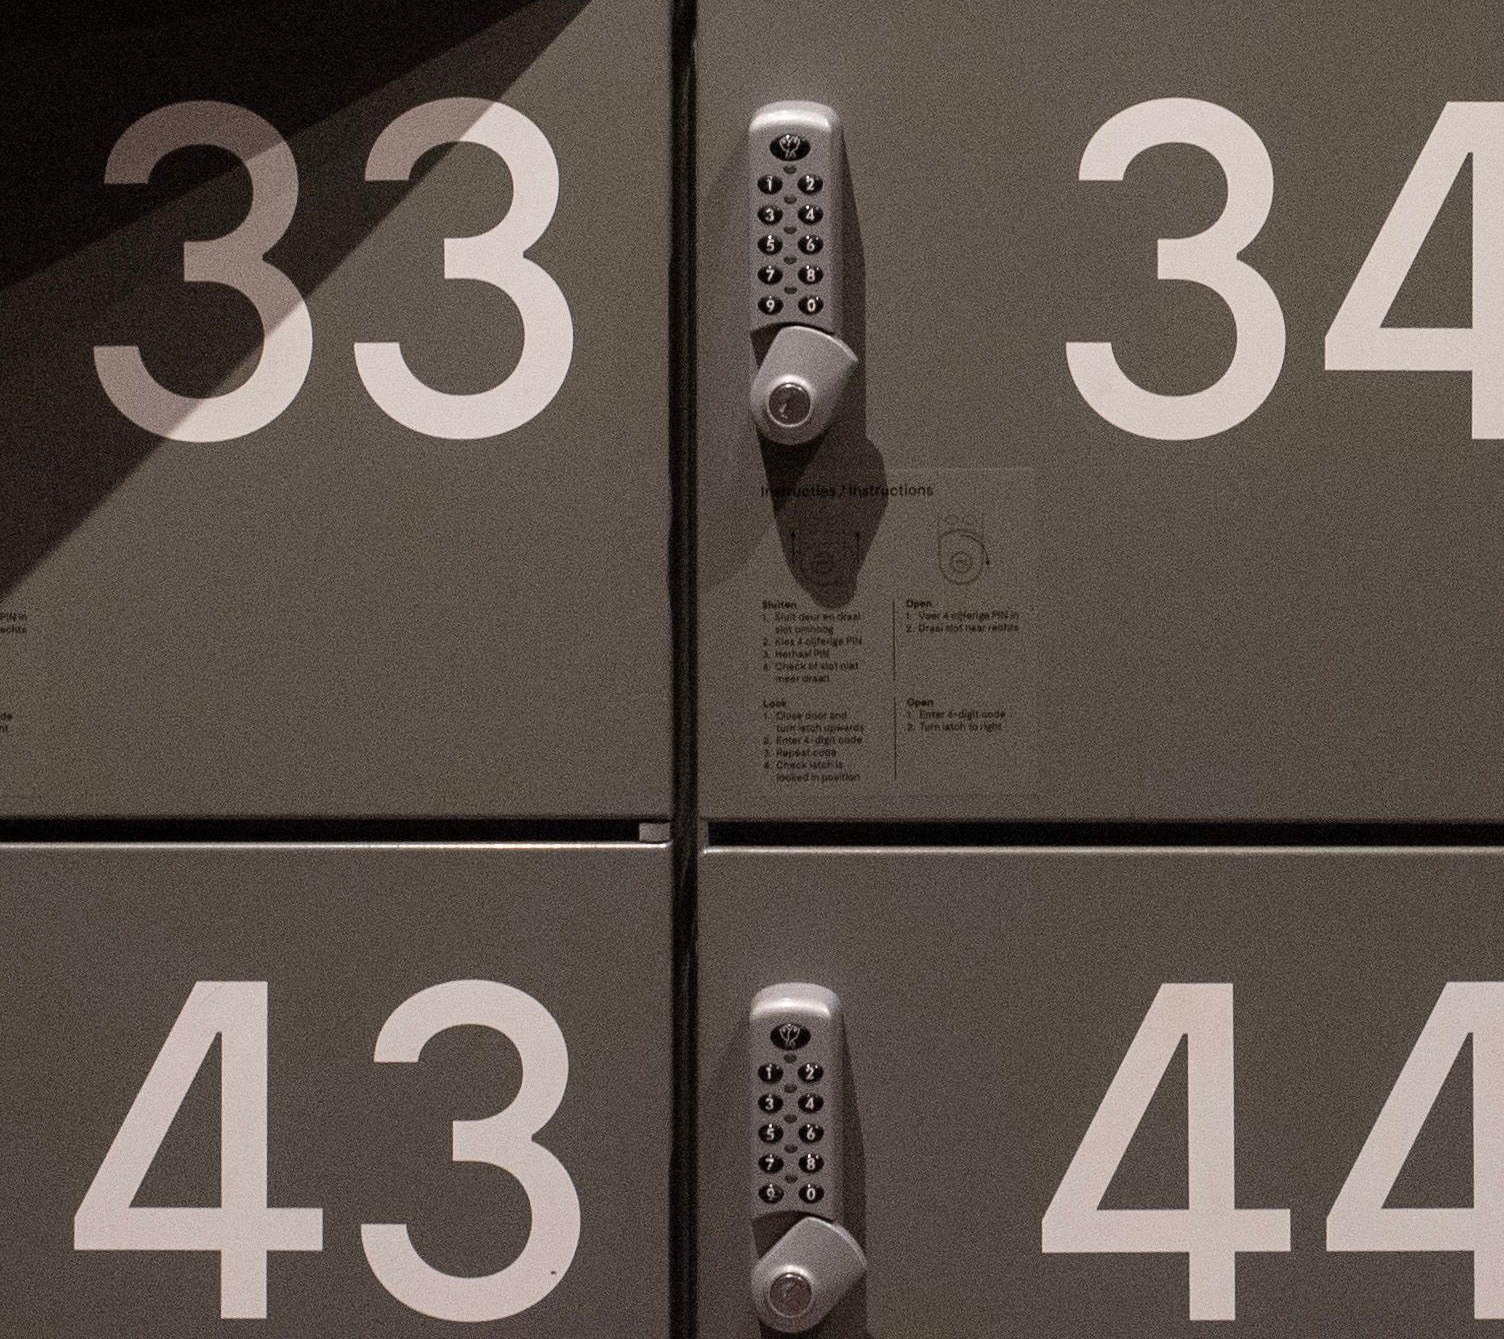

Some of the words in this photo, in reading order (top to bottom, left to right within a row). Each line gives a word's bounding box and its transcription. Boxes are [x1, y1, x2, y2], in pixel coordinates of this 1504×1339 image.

[93, 97, 574, 444] 33
[849, 484, 934, 497] Instructions
[74, 979, 581, 1322] 43
